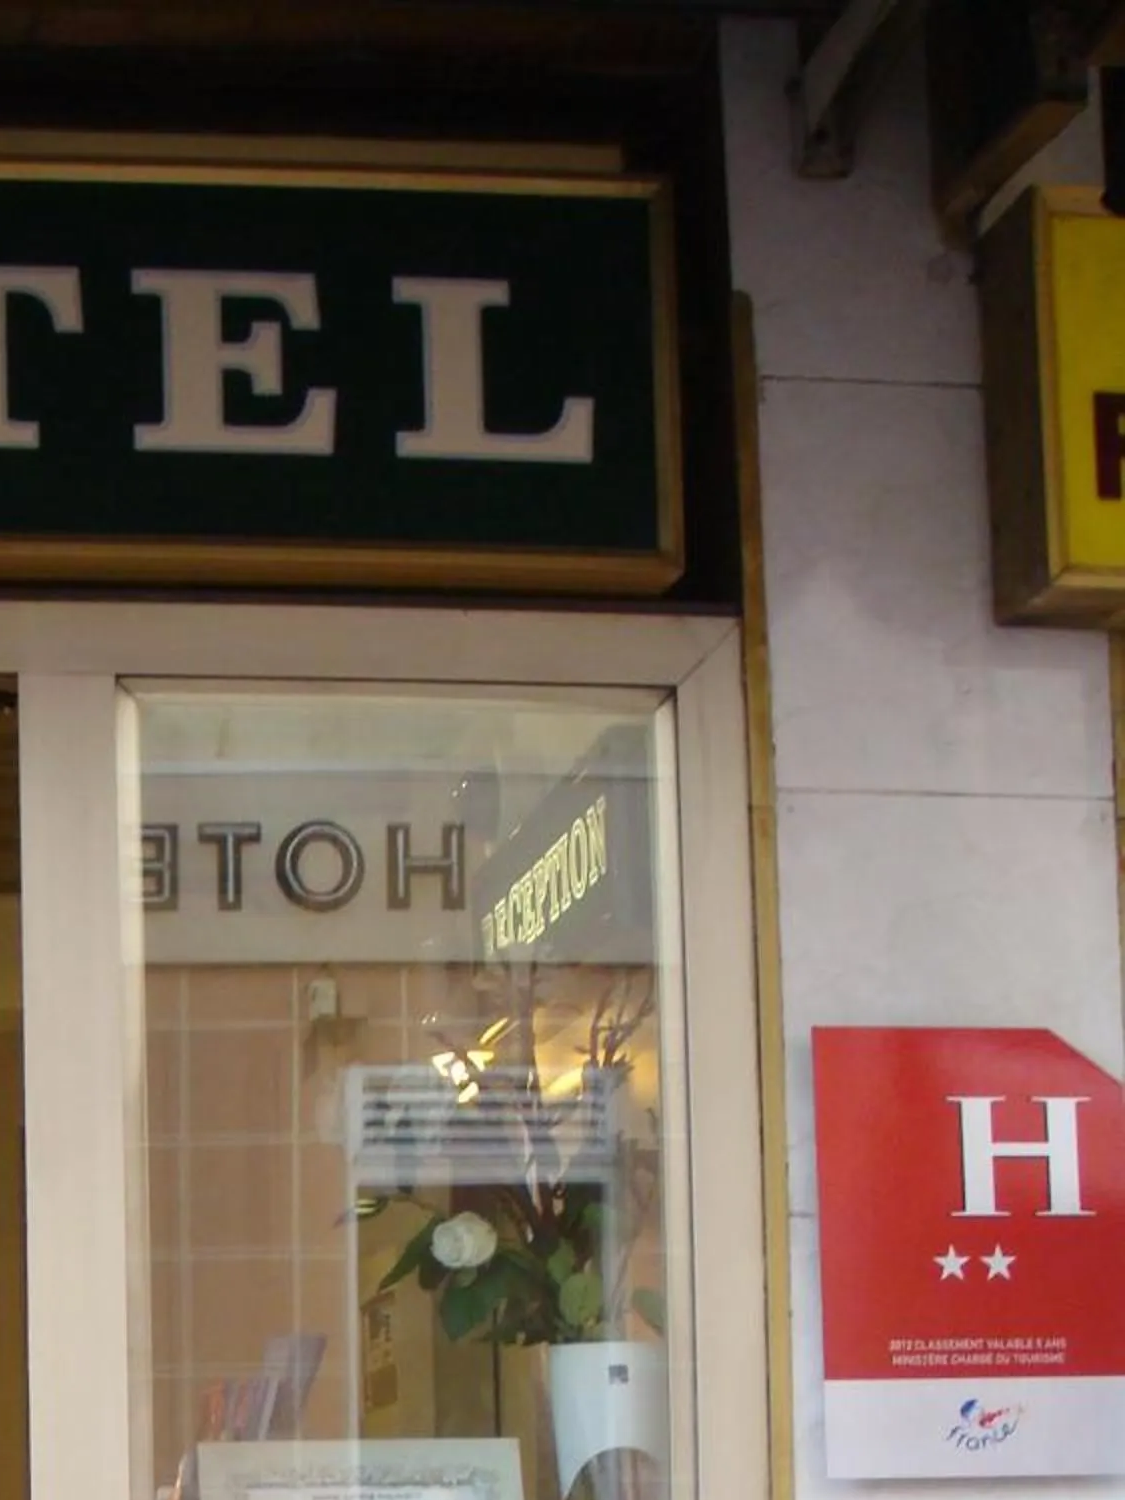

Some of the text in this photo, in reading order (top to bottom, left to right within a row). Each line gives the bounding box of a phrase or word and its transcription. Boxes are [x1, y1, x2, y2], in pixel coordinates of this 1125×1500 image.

[946, 1094, 1097, 1217] H
[914, 1338, 984, 1351] CLASSEMENT
[986, 1337, 1032, 1350] VALABLE
